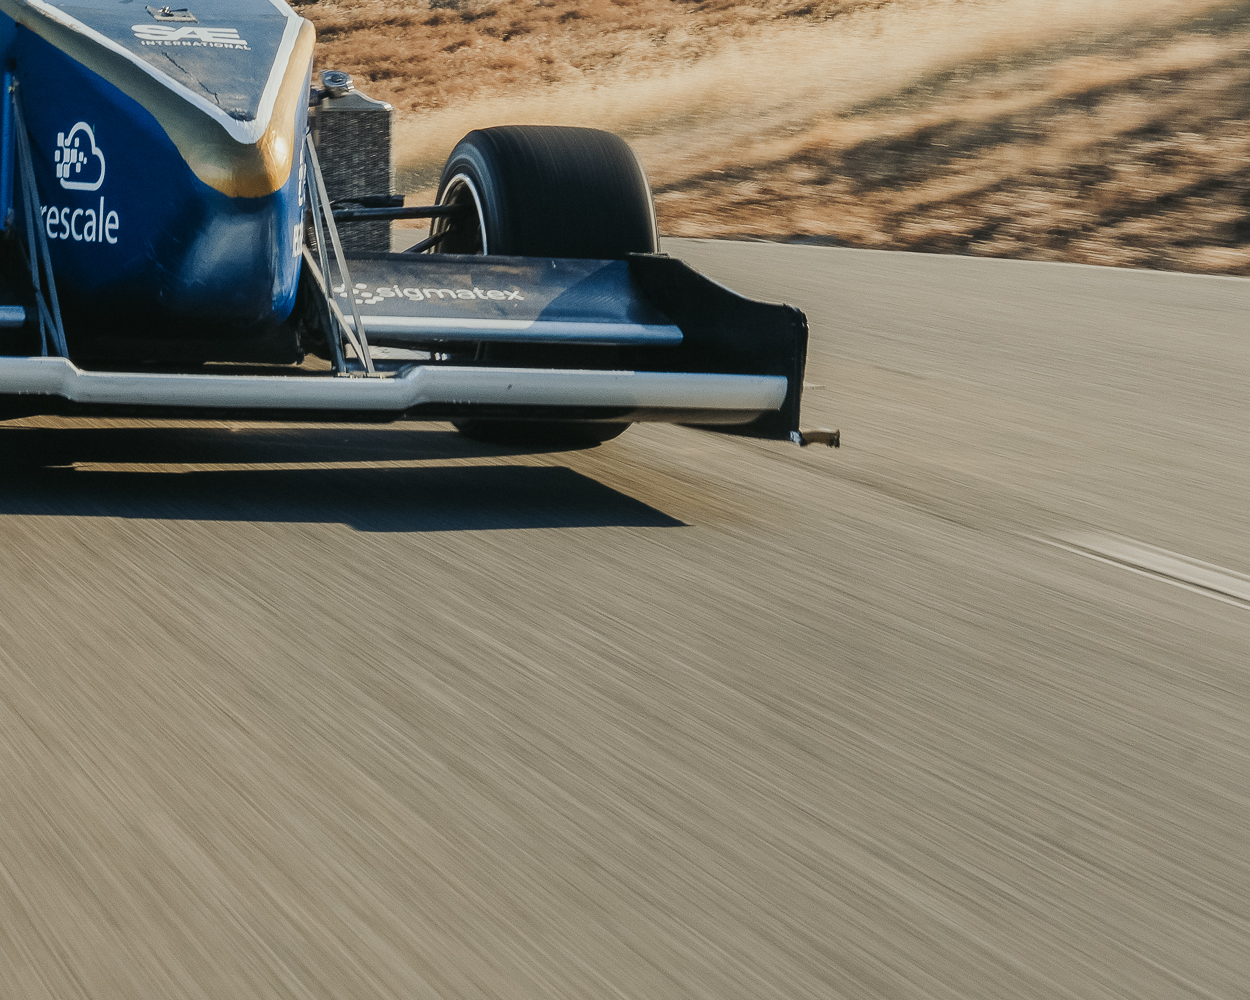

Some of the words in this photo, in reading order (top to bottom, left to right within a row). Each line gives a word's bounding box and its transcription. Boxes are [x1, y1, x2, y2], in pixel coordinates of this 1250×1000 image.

[131, 24, 248, 46] SAE
[141, 40, 252, 51] INTERNATIONAL
[376, 284, 525, 301] sigmatex
